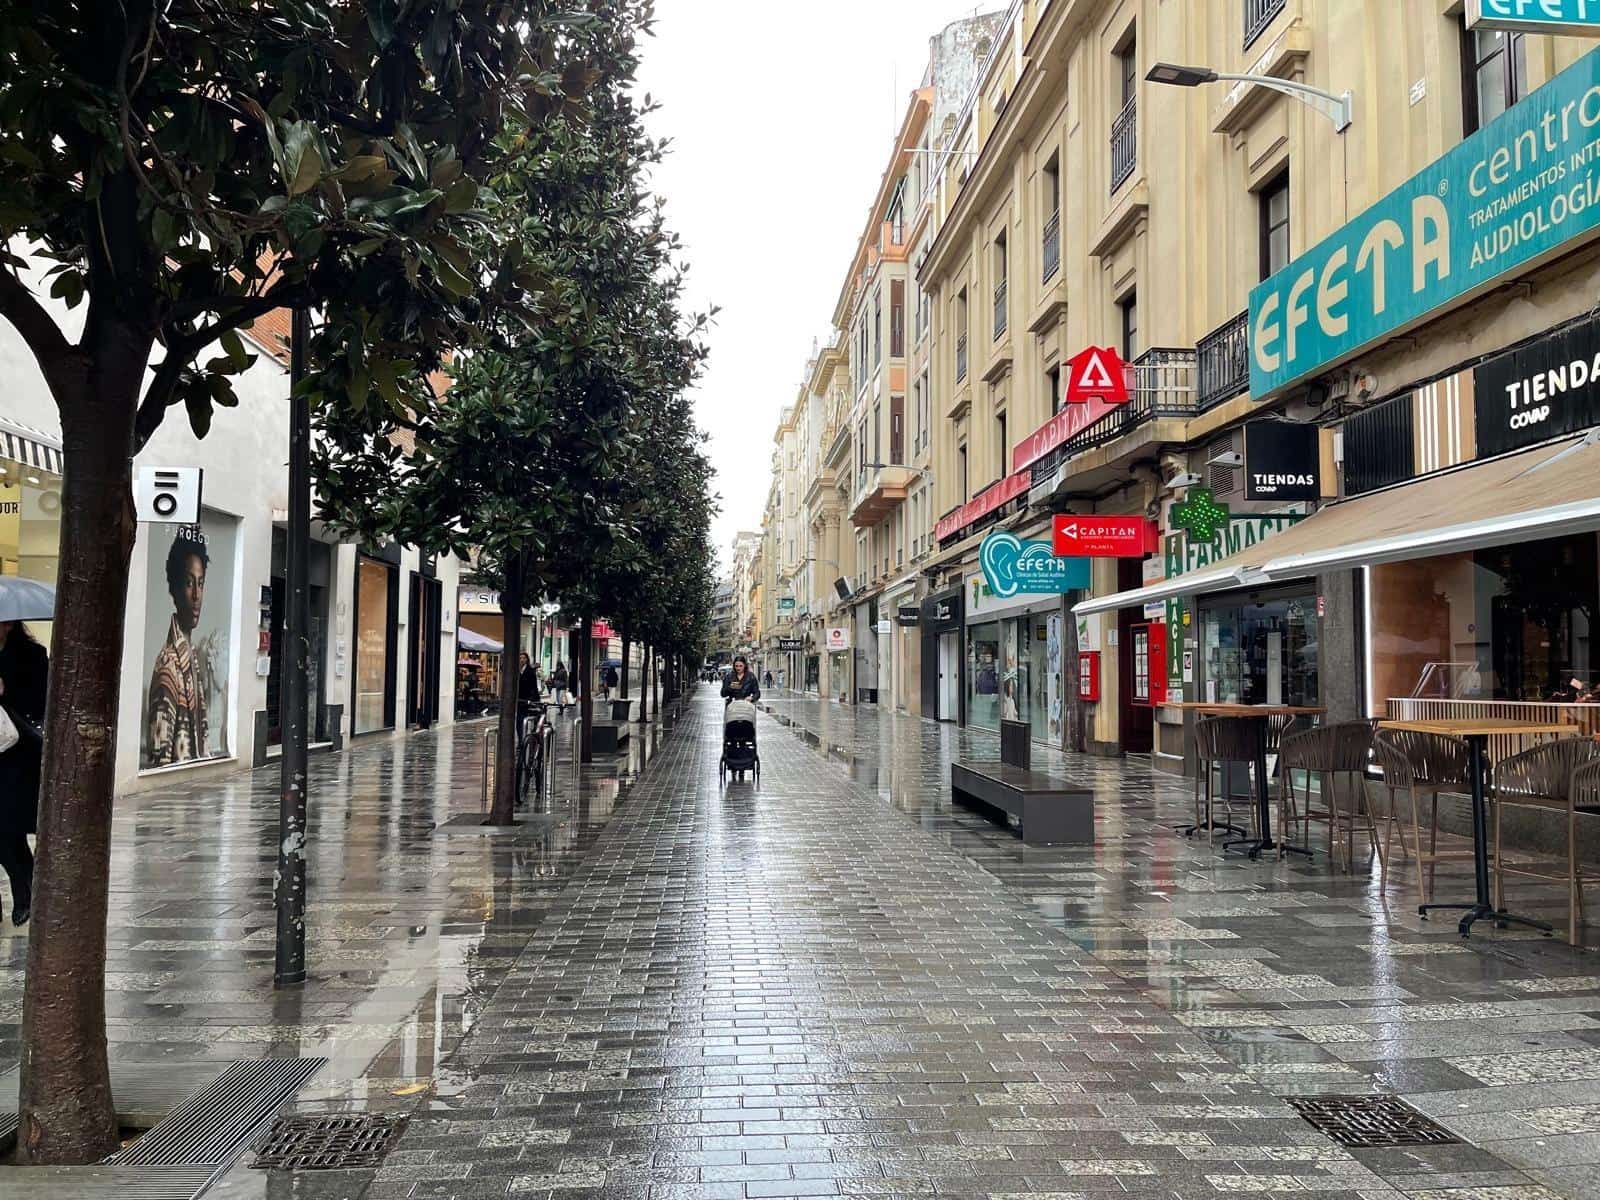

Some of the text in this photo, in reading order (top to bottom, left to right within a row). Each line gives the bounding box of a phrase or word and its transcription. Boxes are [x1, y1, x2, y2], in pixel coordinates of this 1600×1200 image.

[1469, 85, 1600, 197] centro
[1469, 160, 1566, 230] TRATAMIENTOS
[1255, 195, 1450, 373] EFETA
[1033, 402, 1090, 457] CAPITAN
[1510, 405, 1550, 430] COVAP
[1253, 474, 1314, 485] TIENDAS
[1080, 527, 1136, 536] CAPITAN
[1016, 559, 1065, 571] EFETA
